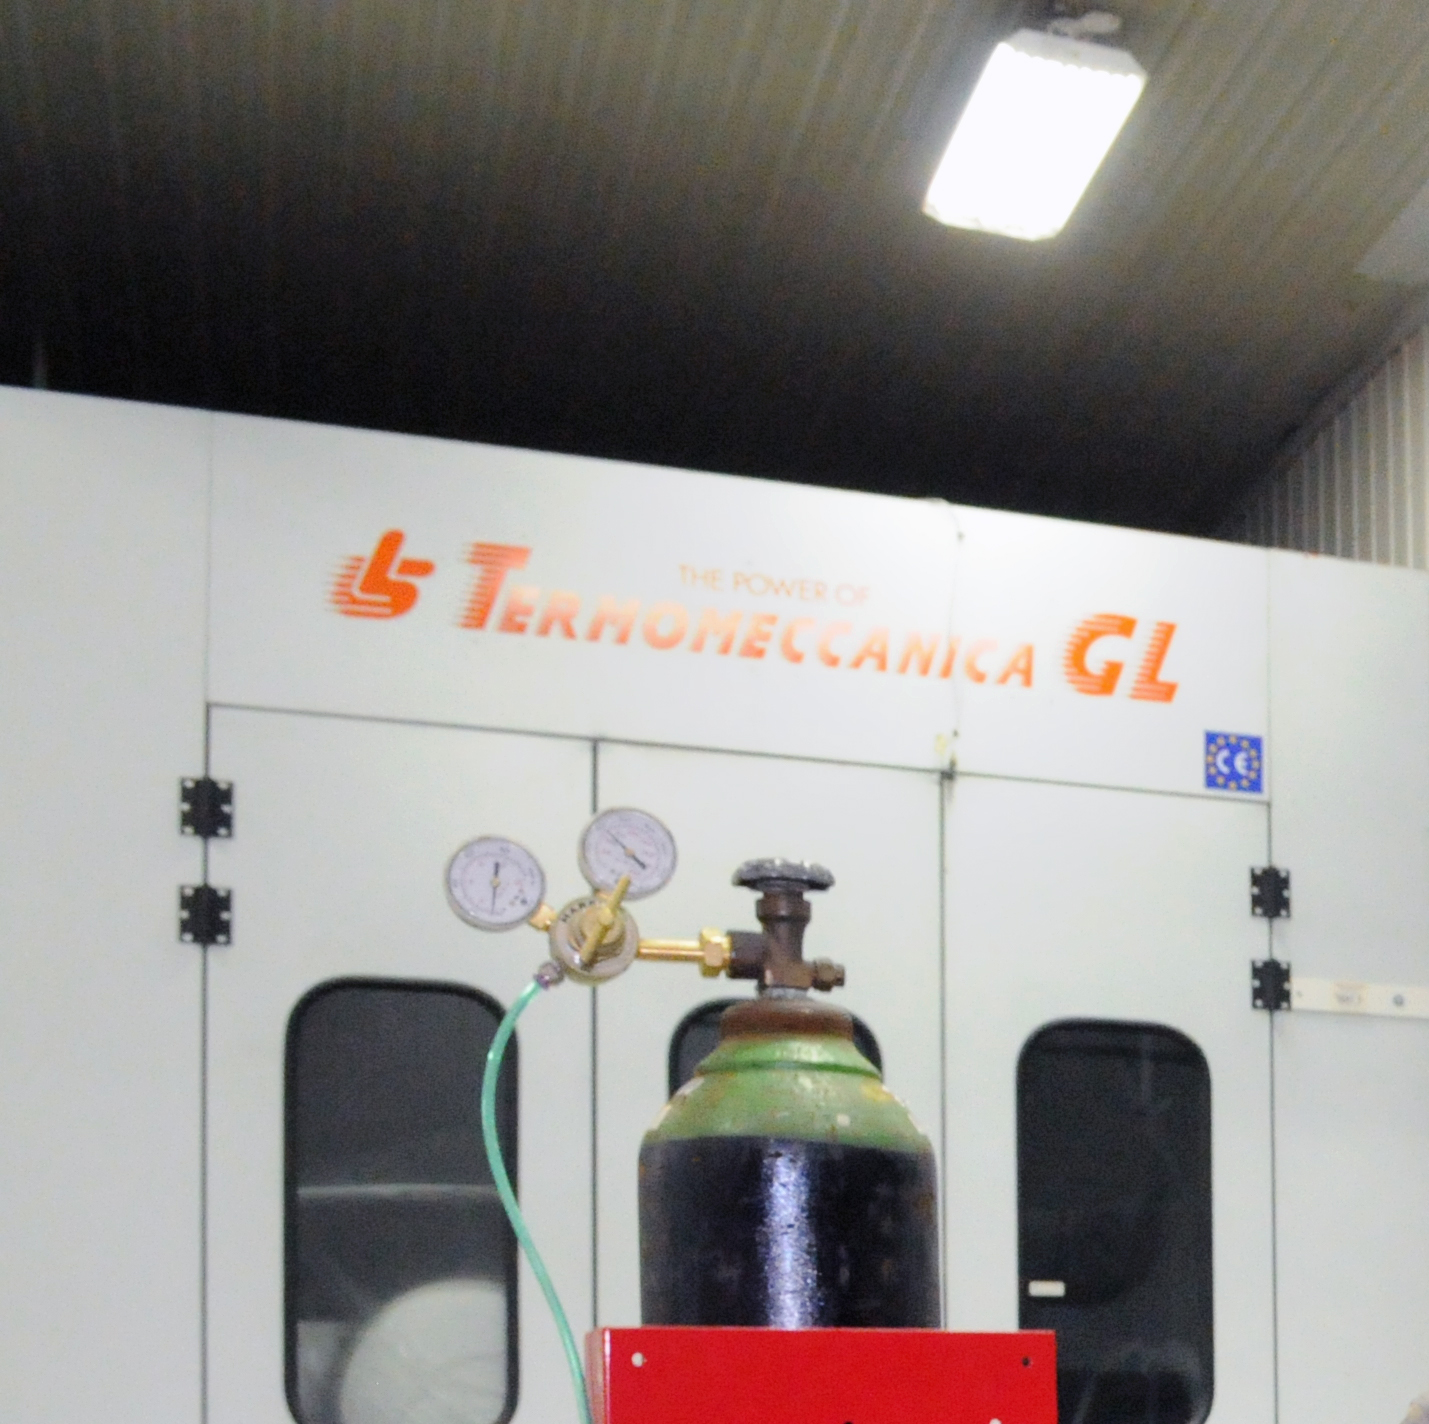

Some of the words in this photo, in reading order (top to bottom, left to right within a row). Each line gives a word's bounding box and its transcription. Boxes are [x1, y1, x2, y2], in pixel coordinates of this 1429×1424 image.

[679, 564, 721, 592] THE
[733, 570, 828, 602] POWER
[835, 583, 871, 607] OF
[1063, 612, 1178, 704] GL
